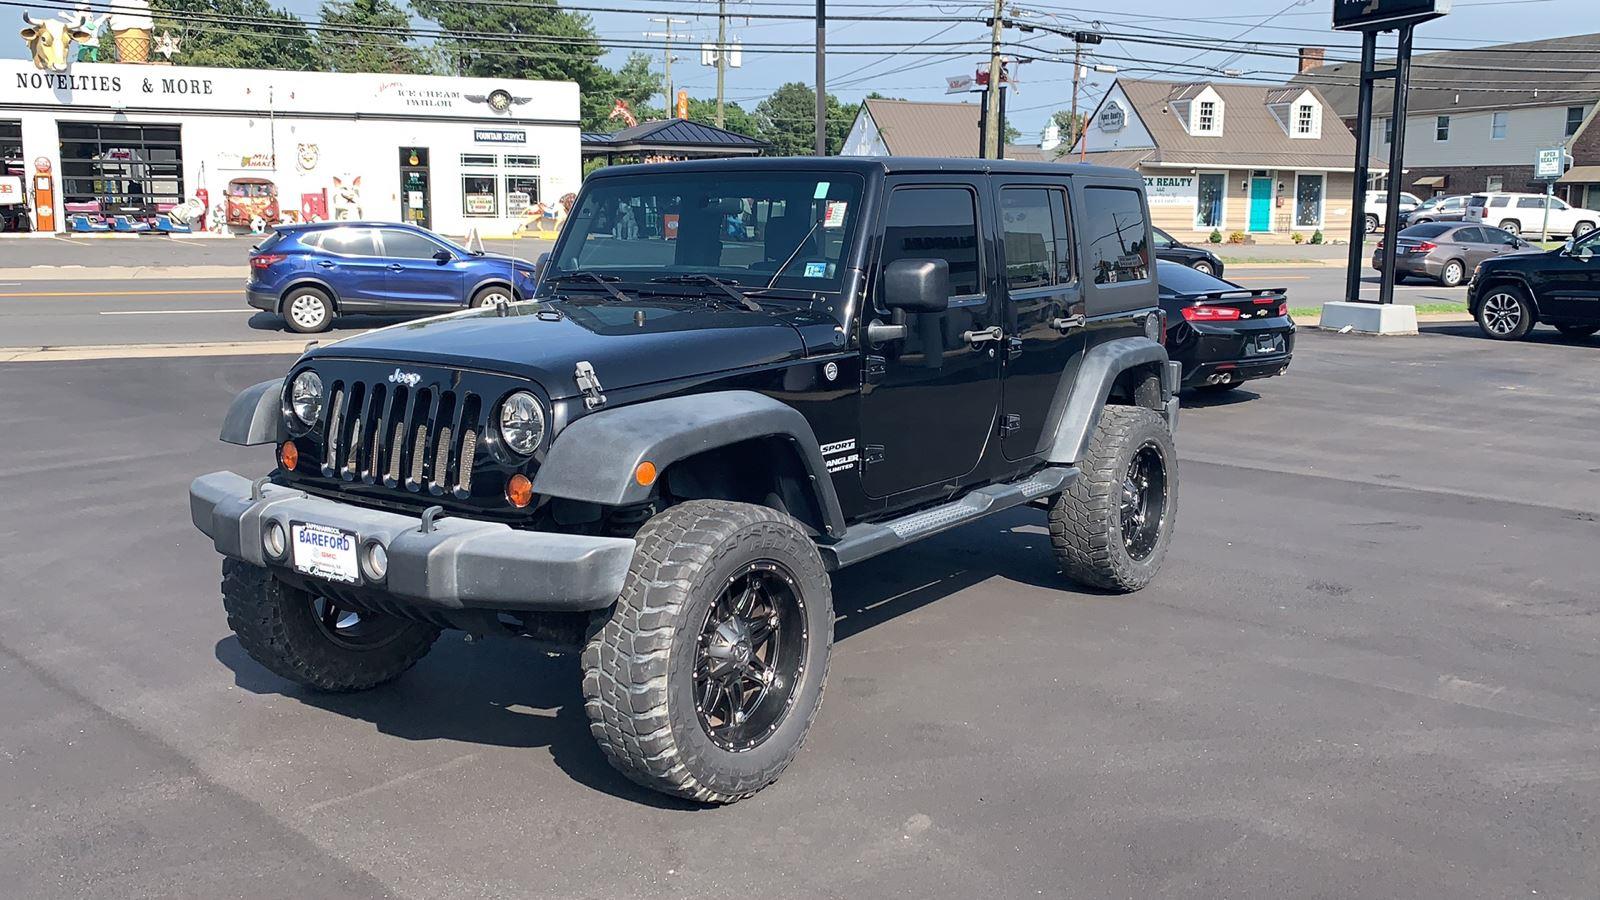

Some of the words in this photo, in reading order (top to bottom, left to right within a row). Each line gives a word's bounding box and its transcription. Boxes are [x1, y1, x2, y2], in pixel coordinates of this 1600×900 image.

[16, 73, 122, 92] NOVELTIES
[142, 77, 154, 93] &
[162, 78, 213, 95] MORE
[398, 89, 416, 97] ICE
[419, 90, 460, 99] CREAM
[406, 99, 452, 107] PARLOR
[503, 132, 525, 141] SERVICE
[1156, 177, 1192, 187] REALTY
[388, 368, 421, 387] Jeep
[821, 441, 854, 454] SPORT
[825, 454, 859, 467] ANGLER
[828, 463, 854, 473] LIMITED
[299, 530, 350, 551] BAREFORD
[321, 551, 337, 560] GMC
